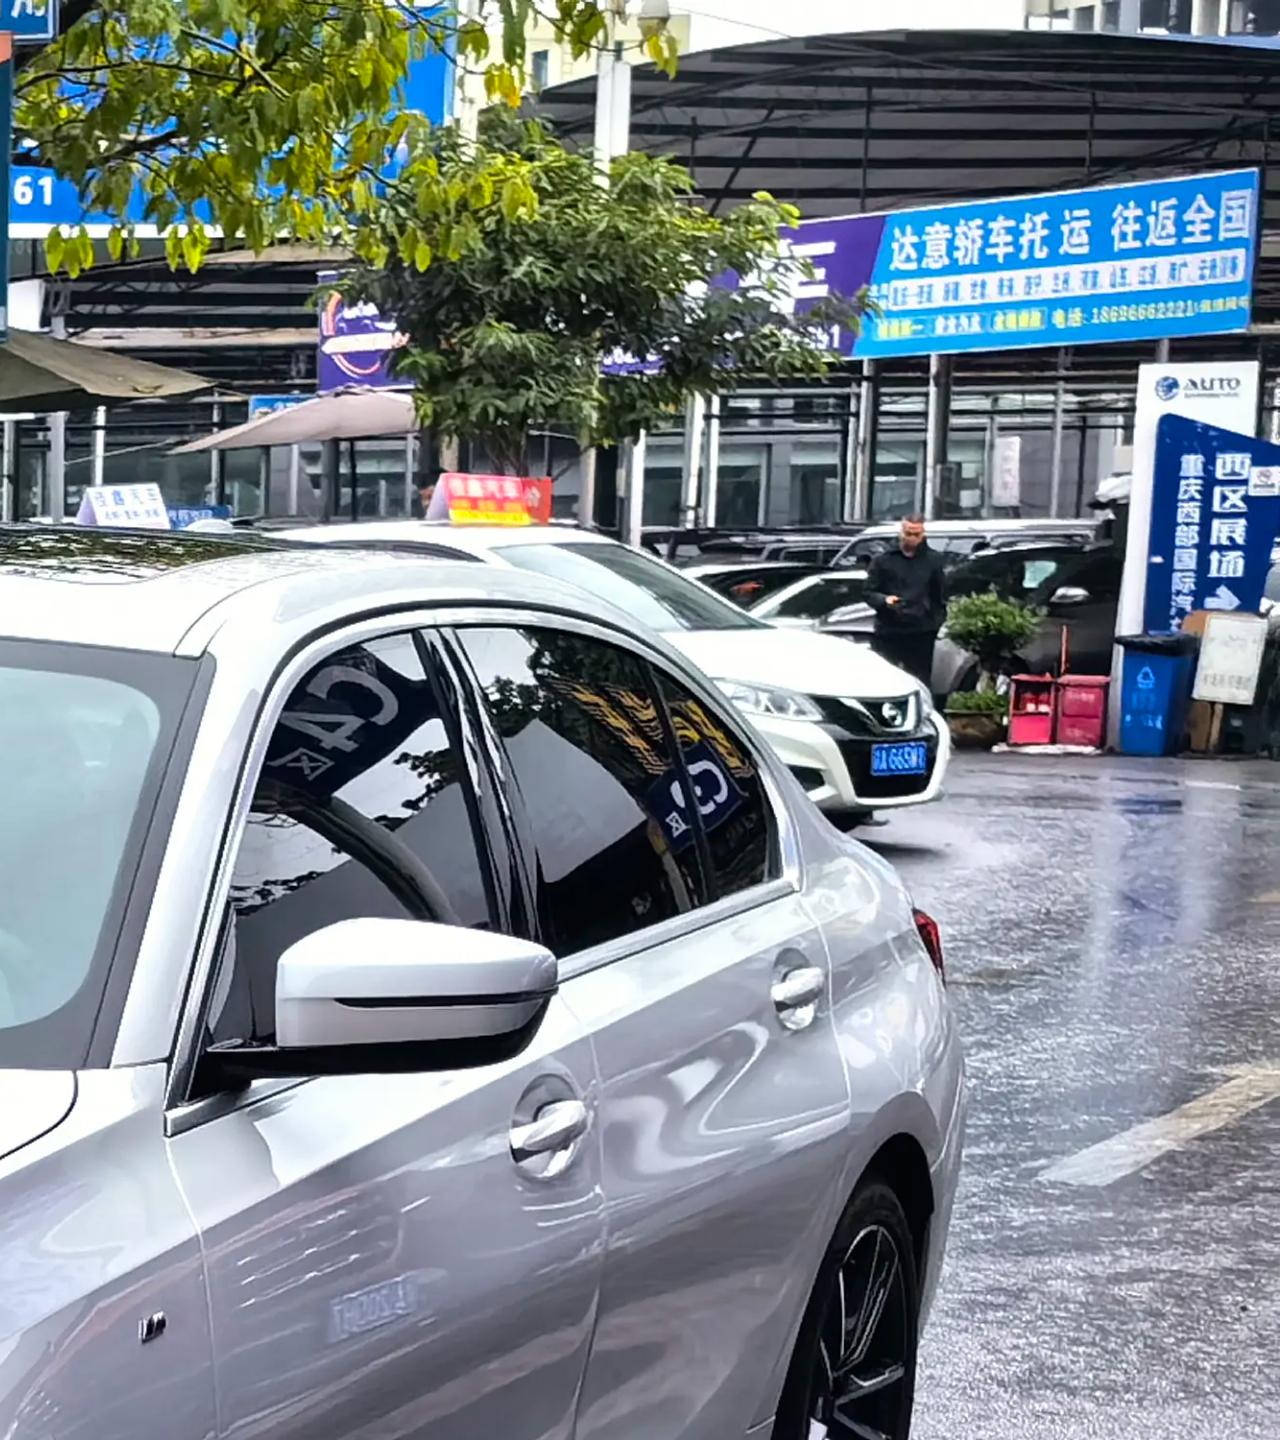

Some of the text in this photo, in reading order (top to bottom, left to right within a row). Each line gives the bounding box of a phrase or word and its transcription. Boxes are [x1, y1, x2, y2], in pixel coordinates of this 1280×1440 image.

[13, 175, 54, 206] 61
[889, 188, 1253, 271] 达意轿车托运 往返全国
[1208, 452, 1252, 578] 西区展场
